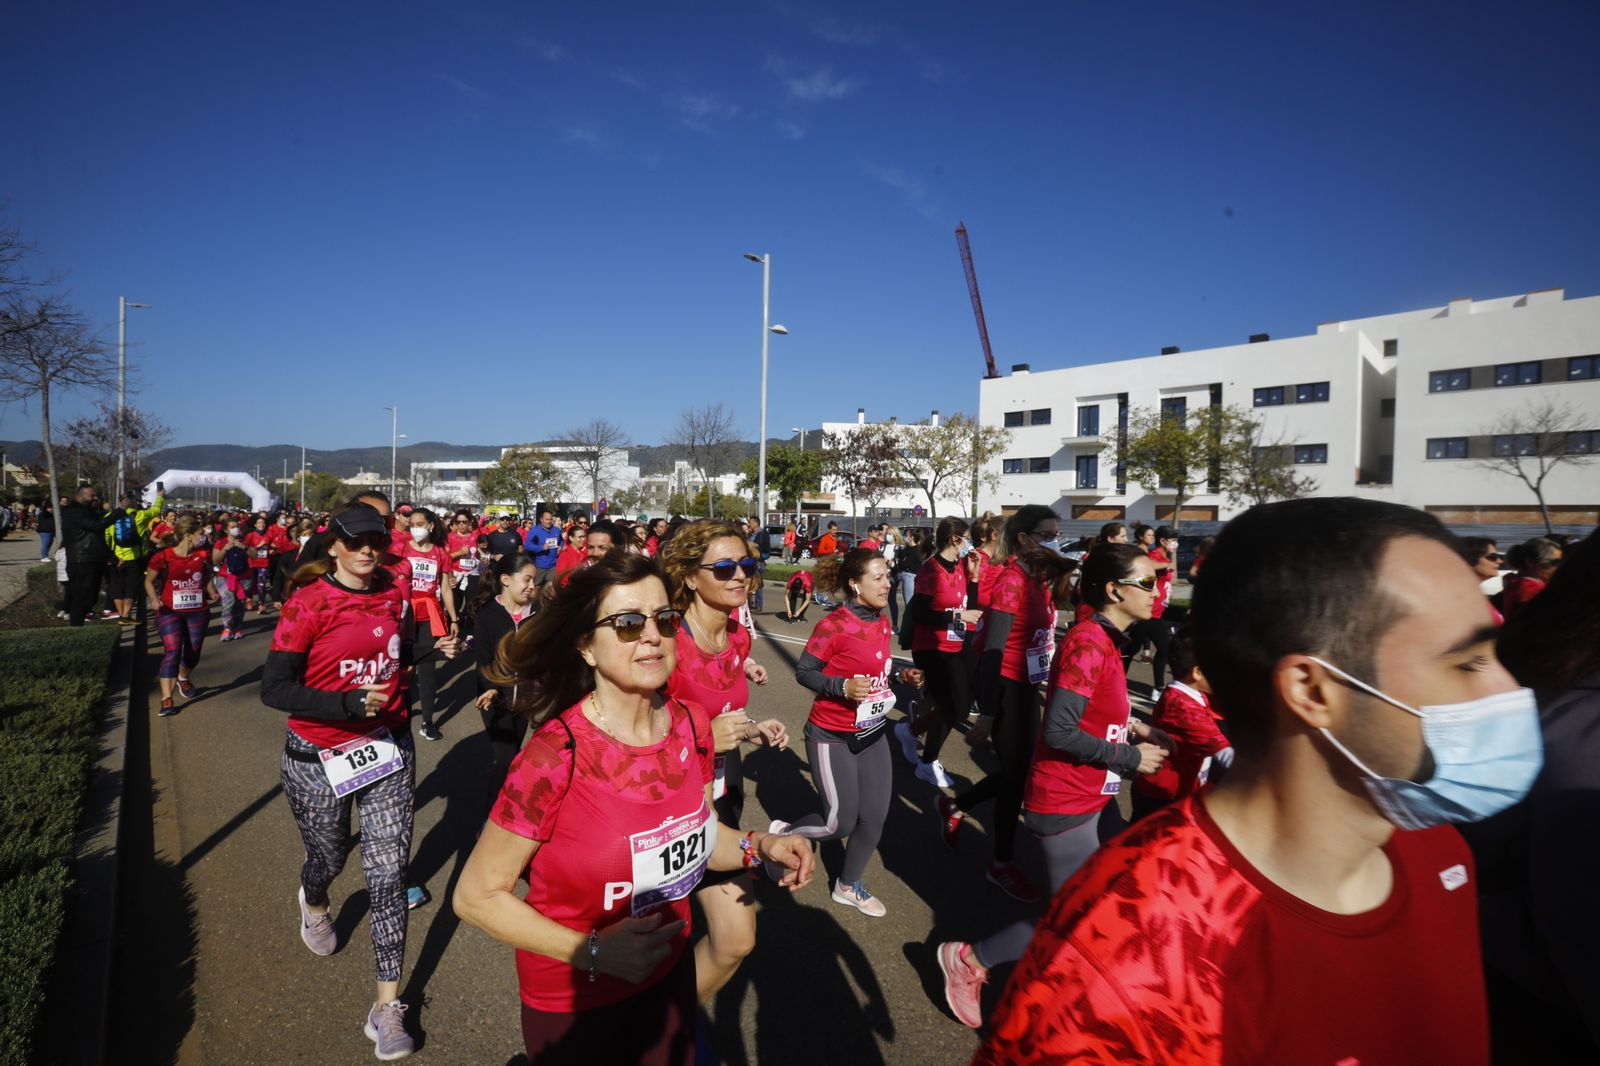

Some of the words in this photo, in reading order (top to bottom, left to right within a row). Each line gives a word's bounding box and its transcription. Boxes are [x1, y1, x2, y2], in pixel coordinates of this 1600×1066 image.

[415, 562, 430, 572] 204
[180, 594, 197, 602] 1210
[339, 652, 390, 678] Pink
[870, 701, 885, 715] 55
[344, 744, 379, 770] 133
[658, 826, 706, 876] 1321
